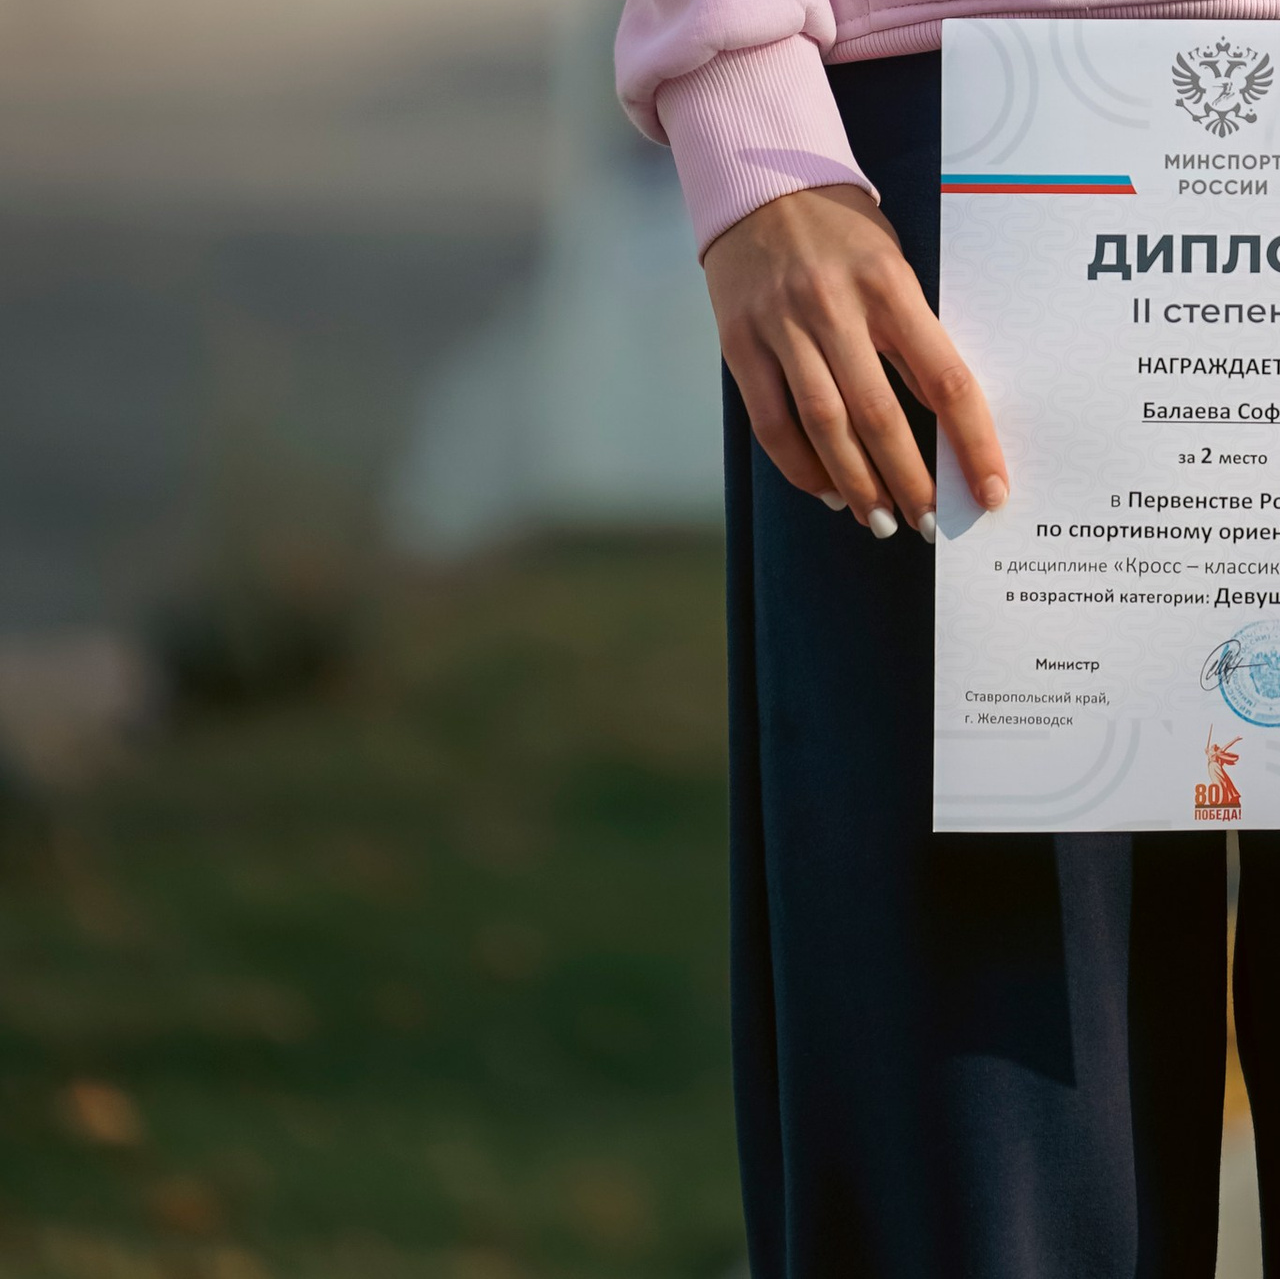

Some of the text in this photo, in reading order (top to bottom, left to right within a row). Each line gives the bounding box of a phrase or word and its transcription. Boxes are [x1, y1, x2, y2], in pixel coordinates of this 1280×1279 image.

[1178, 179, 1267, 195] РОССИИ
[1133, 297, 1149, 323] II
[1143, 401, 1230, 419] Балаева
[1178, 447, 1267, 464] за 2 место
[1110, 494, 1120, 507] в
[1128, 491, 1252, 512] Первенстве
[1036, 524, 1061, 536] по
[1068, 524, 1212, 543] спортивному
[994, 560, 1002, 571] в
[1006, 560, 1107, 574] дисциплине
[1114, 557, 1181, 577] «Кросс
[1006, 591, 1014, 601] в
[1020, 588, 1113, 605] возрастной
[1119, 592, 1209, 607] категории:
[1035, 658, 1099, 672] Министр
[965, 690, 1109, 705] Ставропольский край,
[964, 712, 1072, 727] г. Железноводск
[1195, 783, 1220, 805] 80
[1194, 809, 1241, 822] ПОБЕДА!
